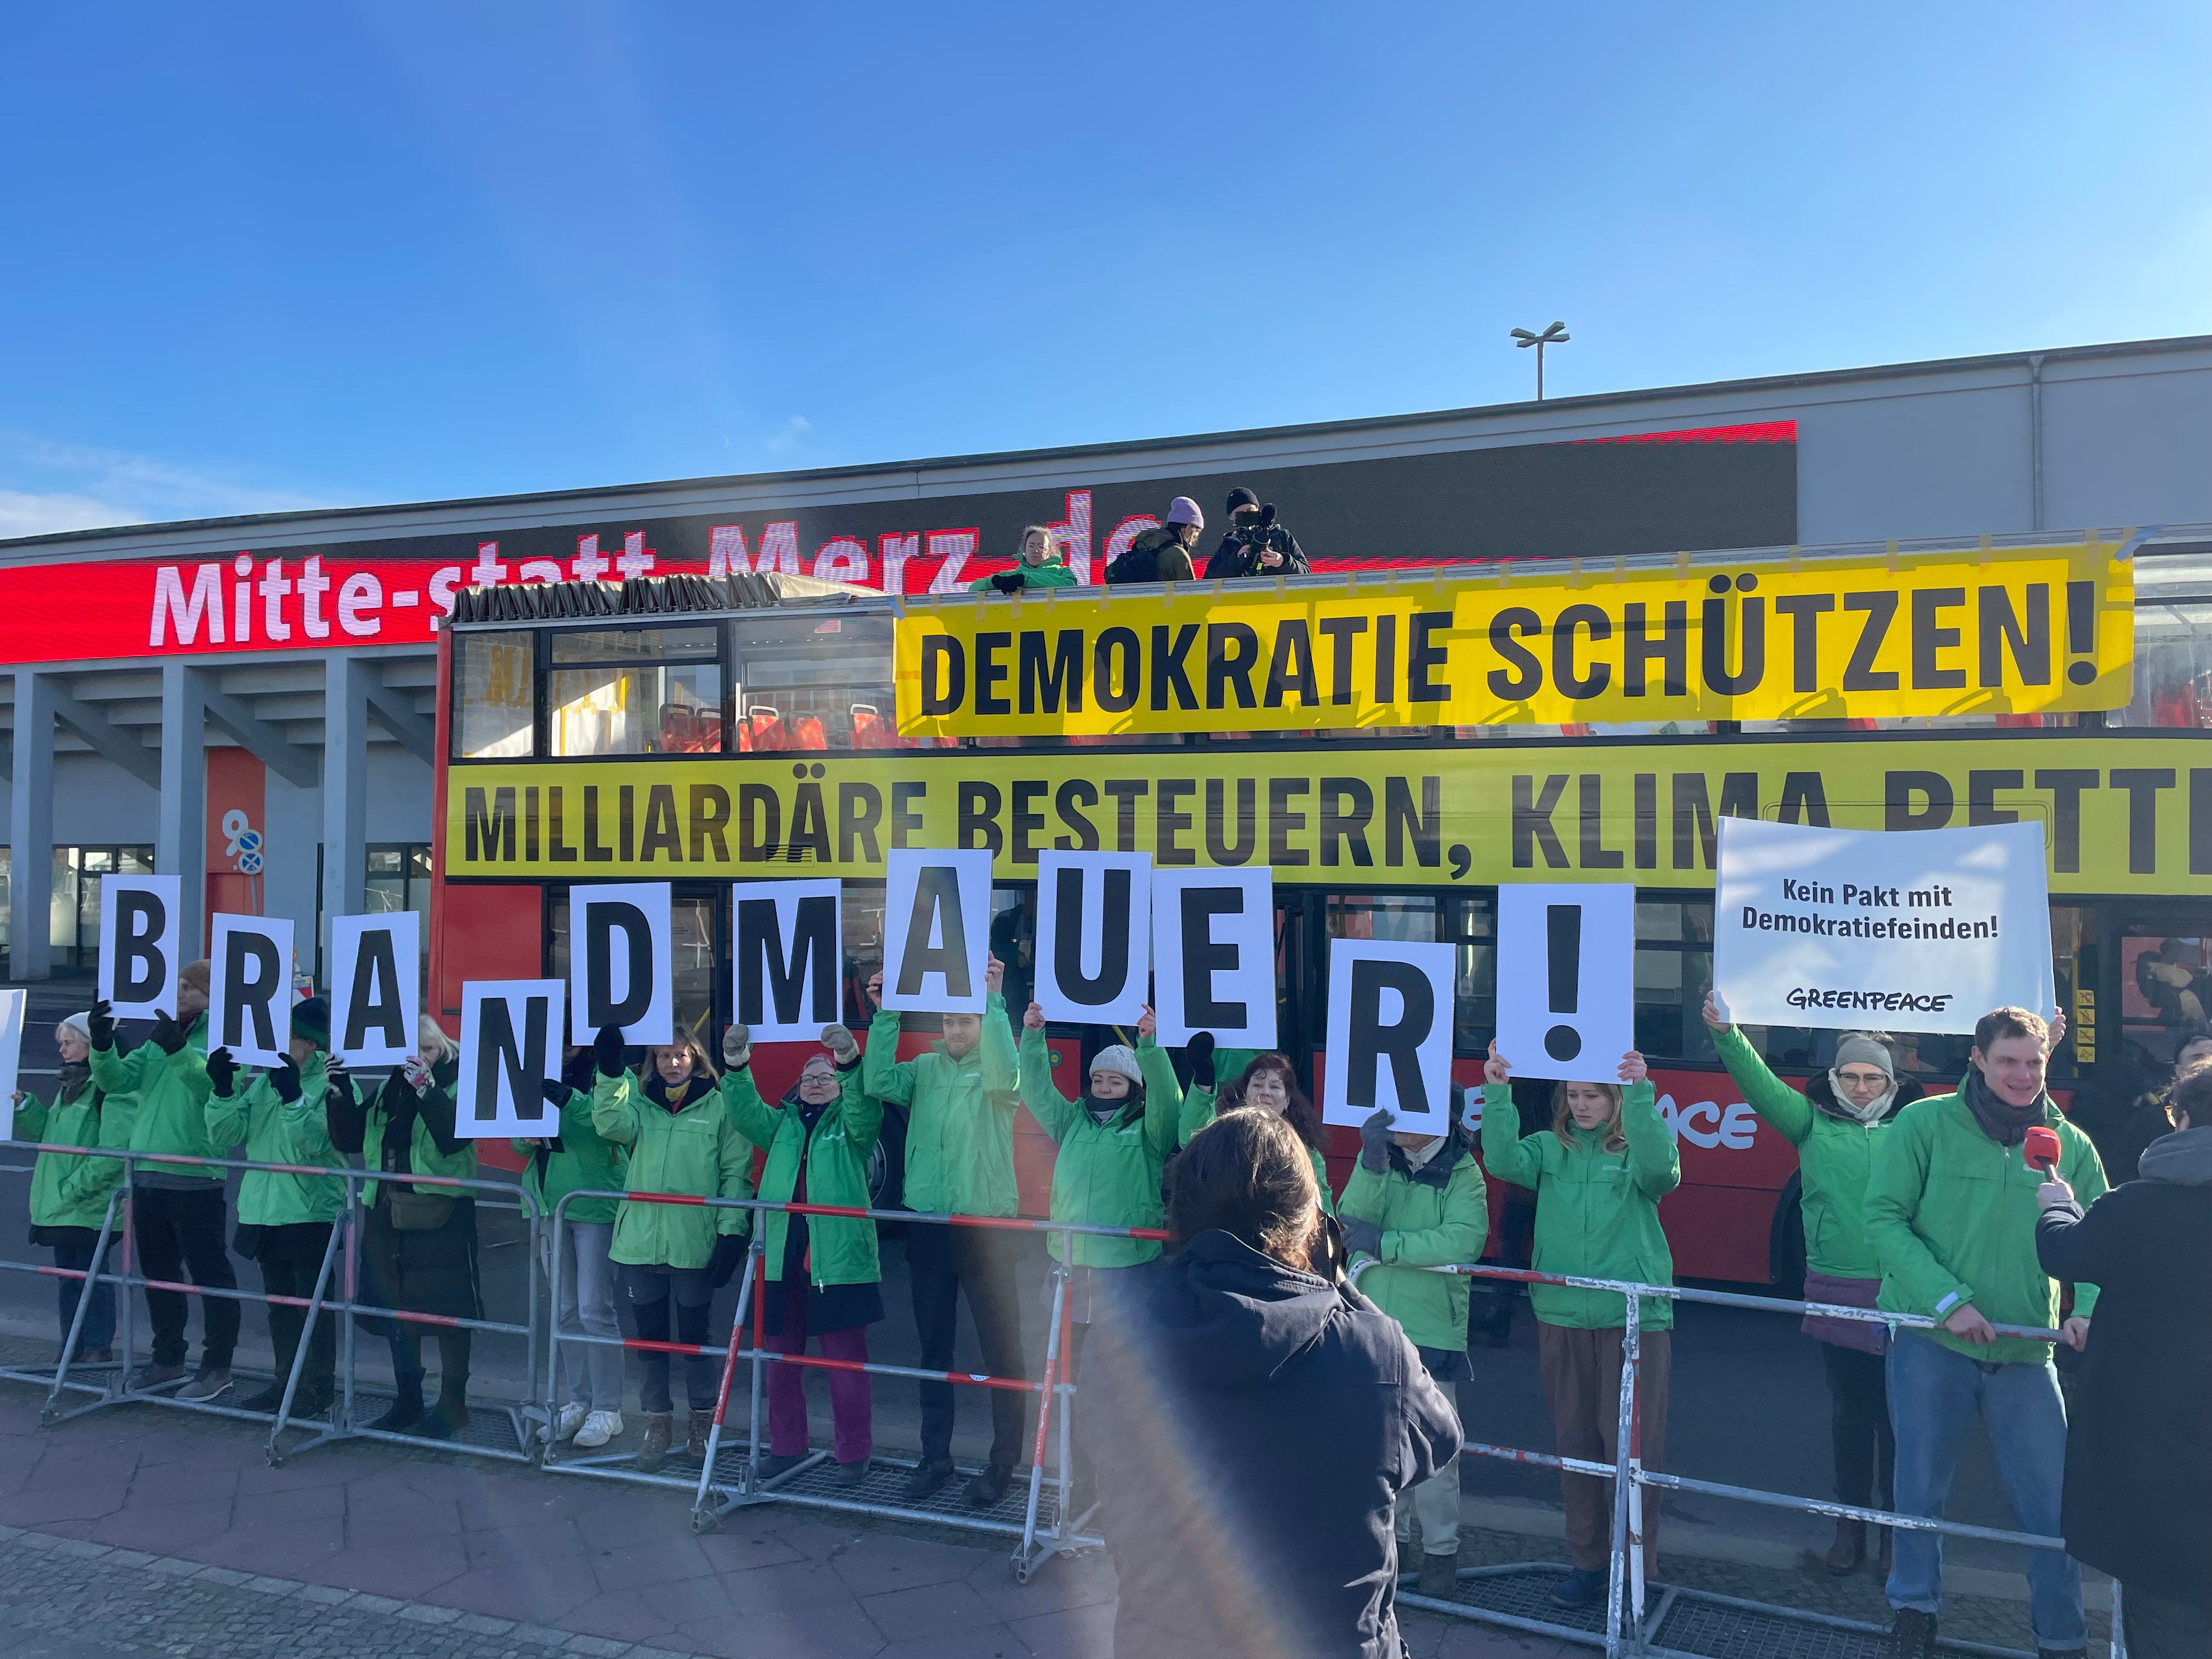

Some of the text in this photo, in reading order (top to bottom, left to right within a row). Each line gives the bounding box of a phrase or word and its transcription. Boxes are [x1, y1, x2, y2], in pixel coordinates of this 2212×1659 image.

[708, 522, 974, 595] Merz
[922, 573, 2097, 716] DEMOKRATIE SCHÜTZEN!
[465, 763, 927, 863] MILLIARDÄRE
[958, 776, 1472, 880] BESTEUERN,
[1512, 772, 1831, 870] KLIMA
[1783, 878, 1953, 907] Kein Pakt mit
[1742, 907, 1999, 939] Demokratiefeinden!
[1786, 988, 1954, 1012] GREENPEACE
